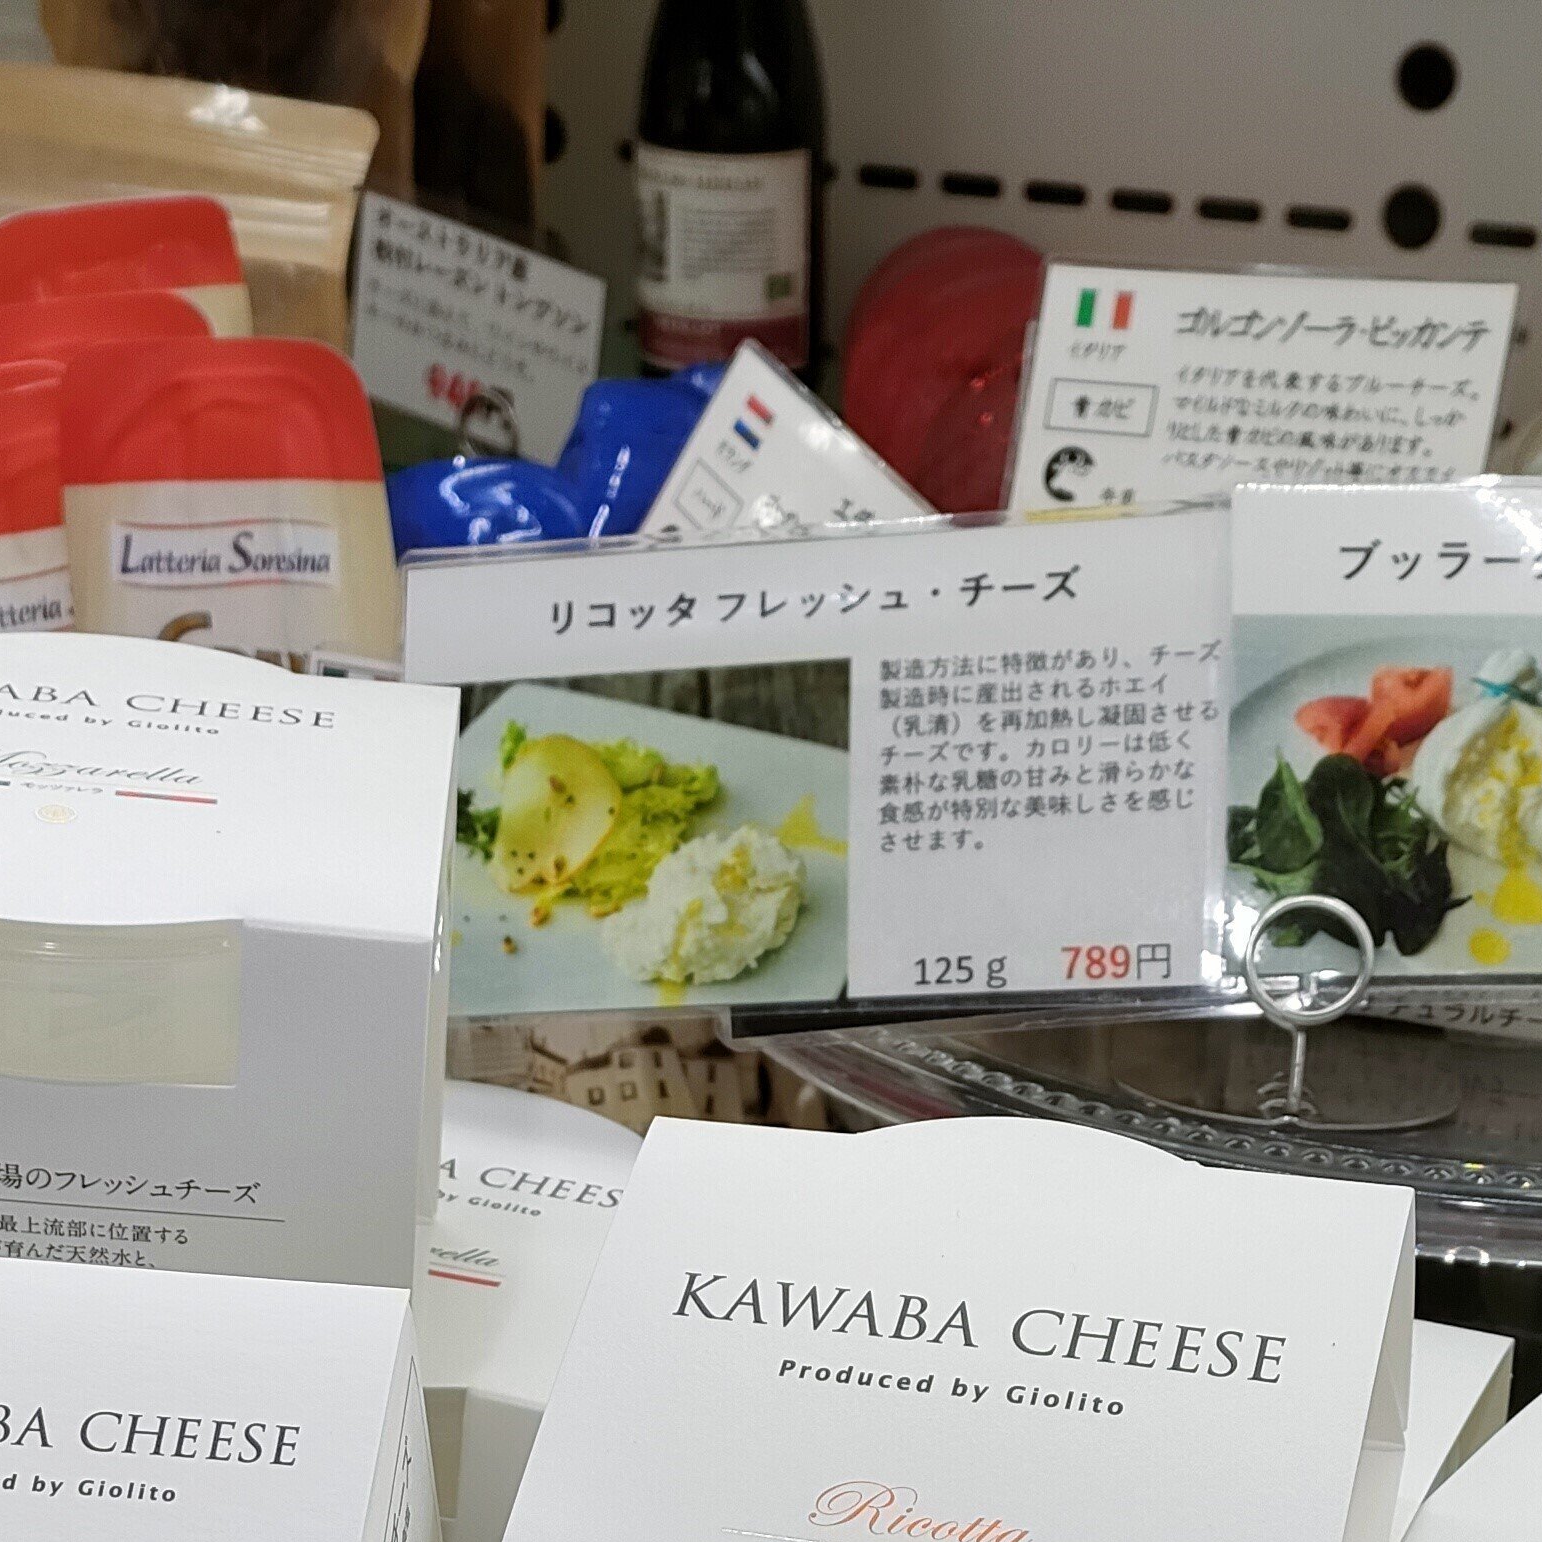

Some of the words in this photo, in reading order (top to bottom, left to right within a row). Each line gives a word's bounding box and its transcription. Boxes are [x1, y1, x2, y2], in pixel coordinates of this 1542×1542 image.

[120, 534, 222, 575] Latteria
[228, 532, 330, 574] Soresina
[551, 592, 697, 635] リコッタ
[717, 564, 1081, 622] フレッシュ・チーズ
[879, 640, 1222, 681] 製造方法に特徴があり、チーズ
[879, 673, 1168, 709] 製造時に産出されるホエイ
[84, 715, 111, 727] by
[128, 719, 222, 736] Giolito
[125, 693, 337, 730] CHEESE
[879, 730, 1191, 767] チーズです。カロリーは低く
[879, 758, 1195, 797] 素朴な乳糖の甘みと滑らかな
[879, 788, 1195, 826] 食感が特別な美味しさを感じ
[879, 827, 985, 853] させます。
[915, 956, 974, 985] 125
[986, 956, 1008, 989] g
[1061, 943, 1173, 981] 789円
[469, 1195, 541, 1217] Giolito
[480, 1167, 625, 1208] CHEES
[671, 1270, 980, 1349] KAWABA
[1011, 1309, 1288, 1385] CHEESE
[777, 1357, 934, 1395] Produced
[950, 1377, 990, 1404] by
[1005, 1384, 1126, 1417] Giolito
[79, 1411, 302, 1467] CHEESE
[31, 1474, 64, 1497] by
[77, 1478, 178, 1503] Giolito
